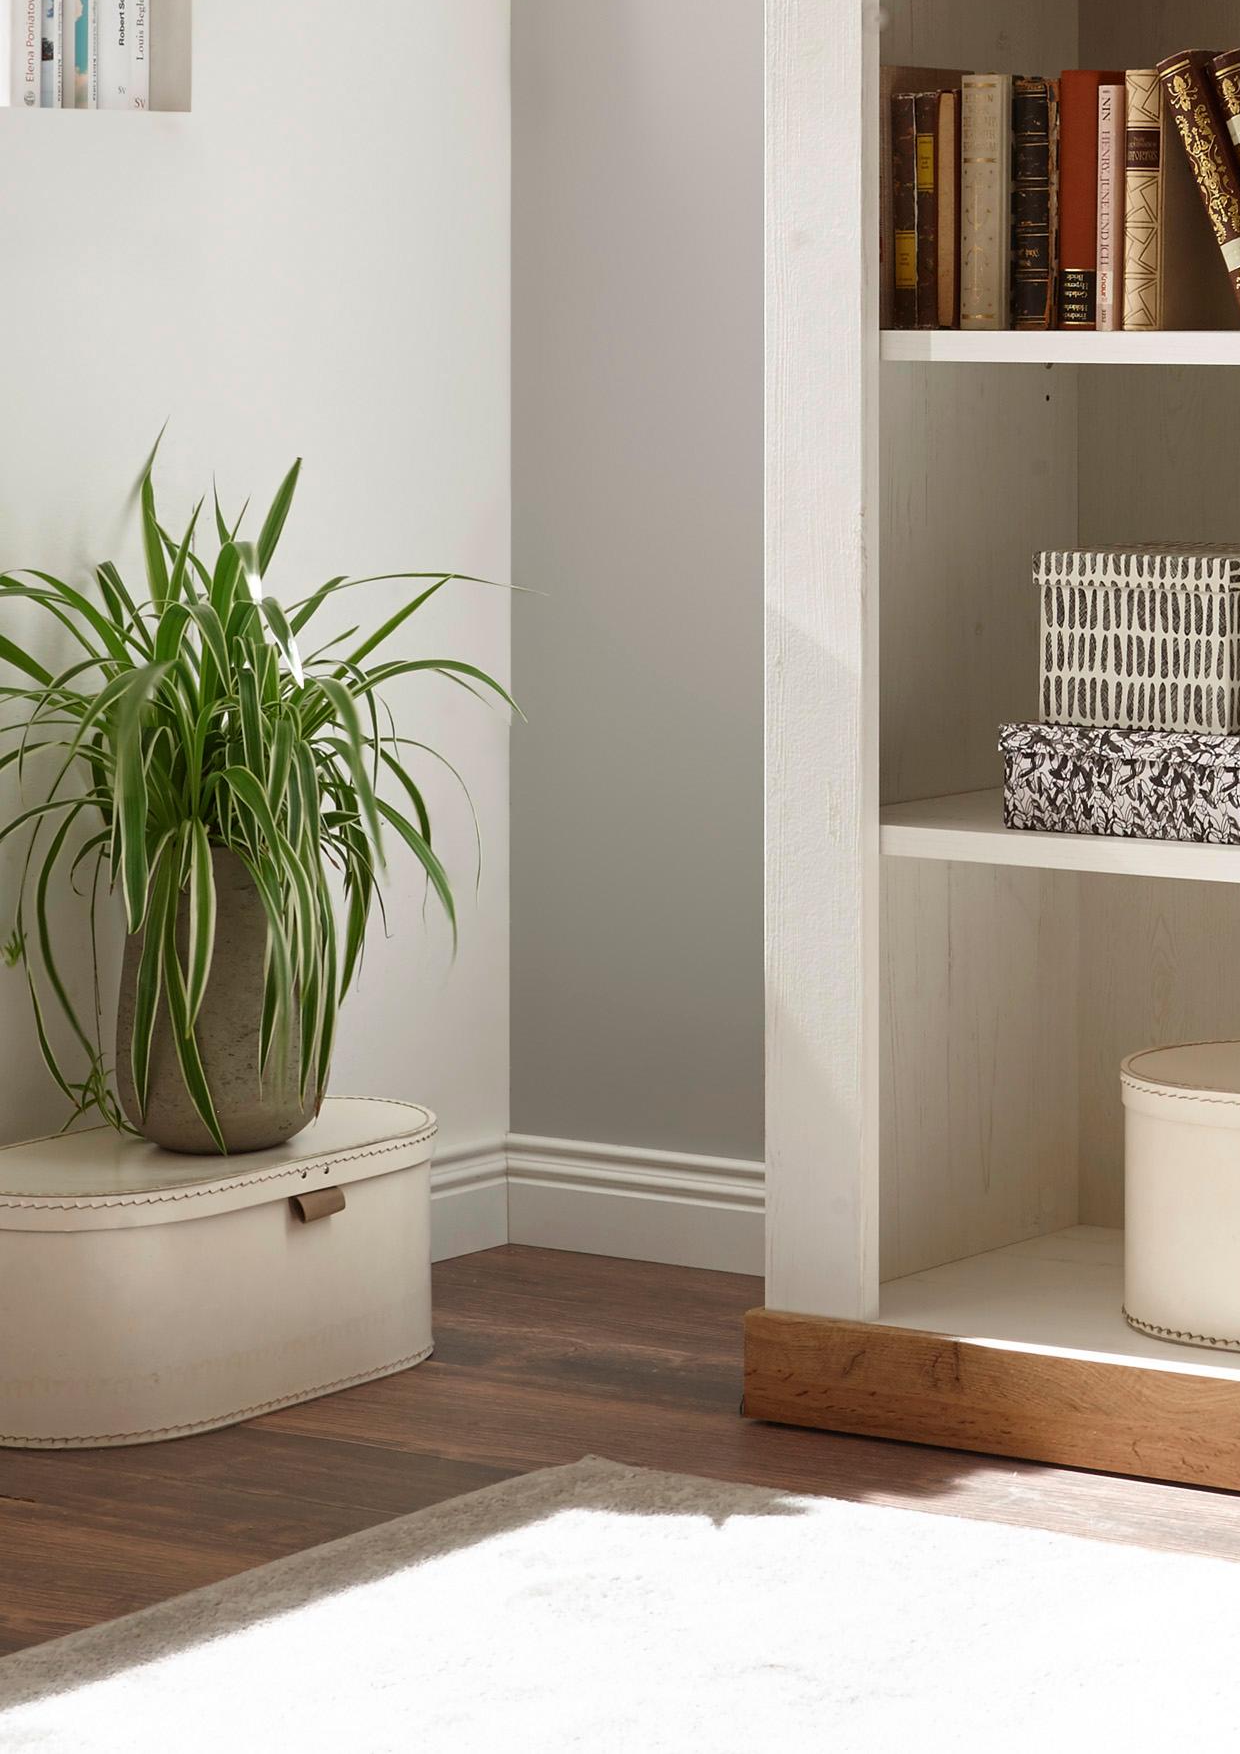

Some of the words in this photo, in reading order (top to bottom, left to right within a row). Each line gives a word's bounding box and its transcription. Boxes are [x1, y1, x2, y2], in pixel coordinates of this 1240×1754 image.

[136, 29, 144, 61] Louis
[26, 50, 34, 83] Elena
[1102, 97, 1111, 121] NIN
[1100, 175, 1110, 209] JUNE
[1100, 212, 1109, 240] UND
[1100, 243, 1109, 266] ICH
[1100, 272, 1109, 297] Knaur
